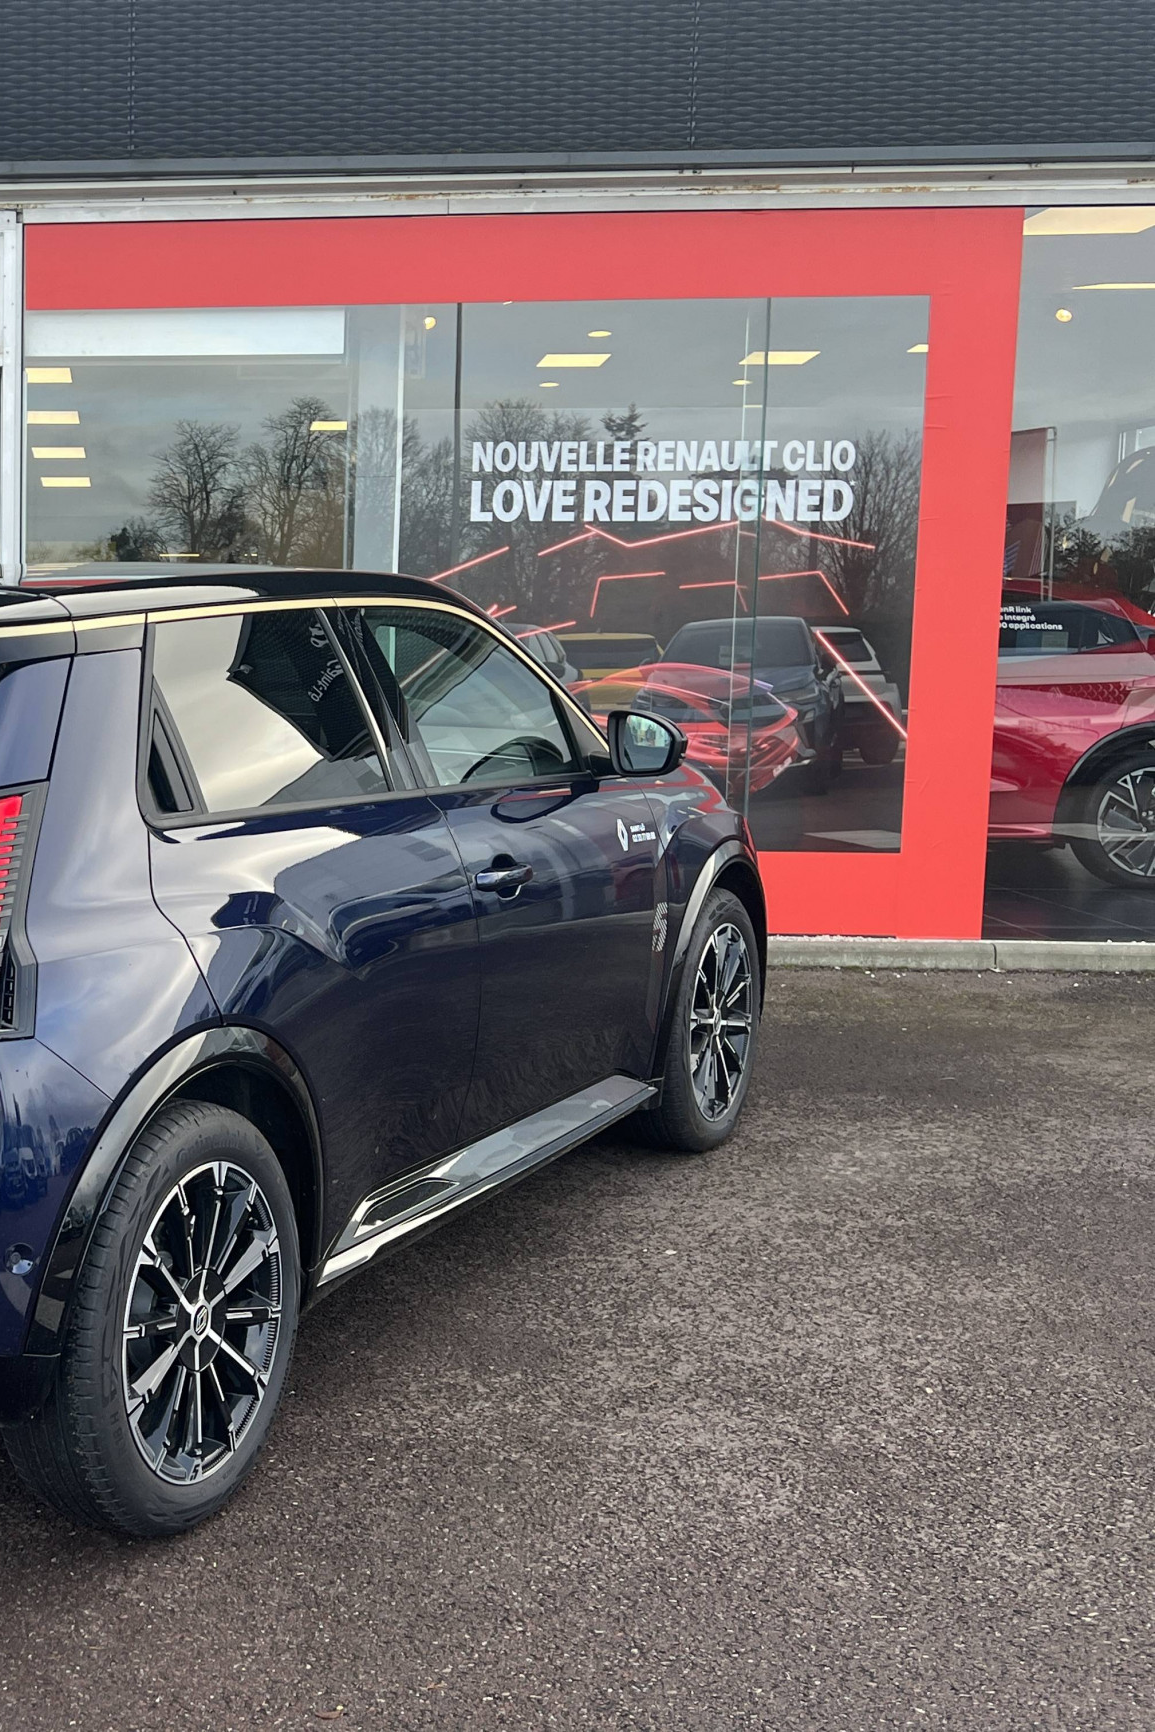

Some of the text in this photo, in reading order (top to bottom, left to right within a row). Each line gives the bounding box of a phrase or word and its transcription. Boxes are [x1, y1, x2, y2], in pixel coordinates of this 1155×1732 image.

[471, 440, 856, 472] NOUVELLE RENAULT CLIO
[469, 480, 576, 522] LOVE
[1008, 622, 1063, 631] applications
